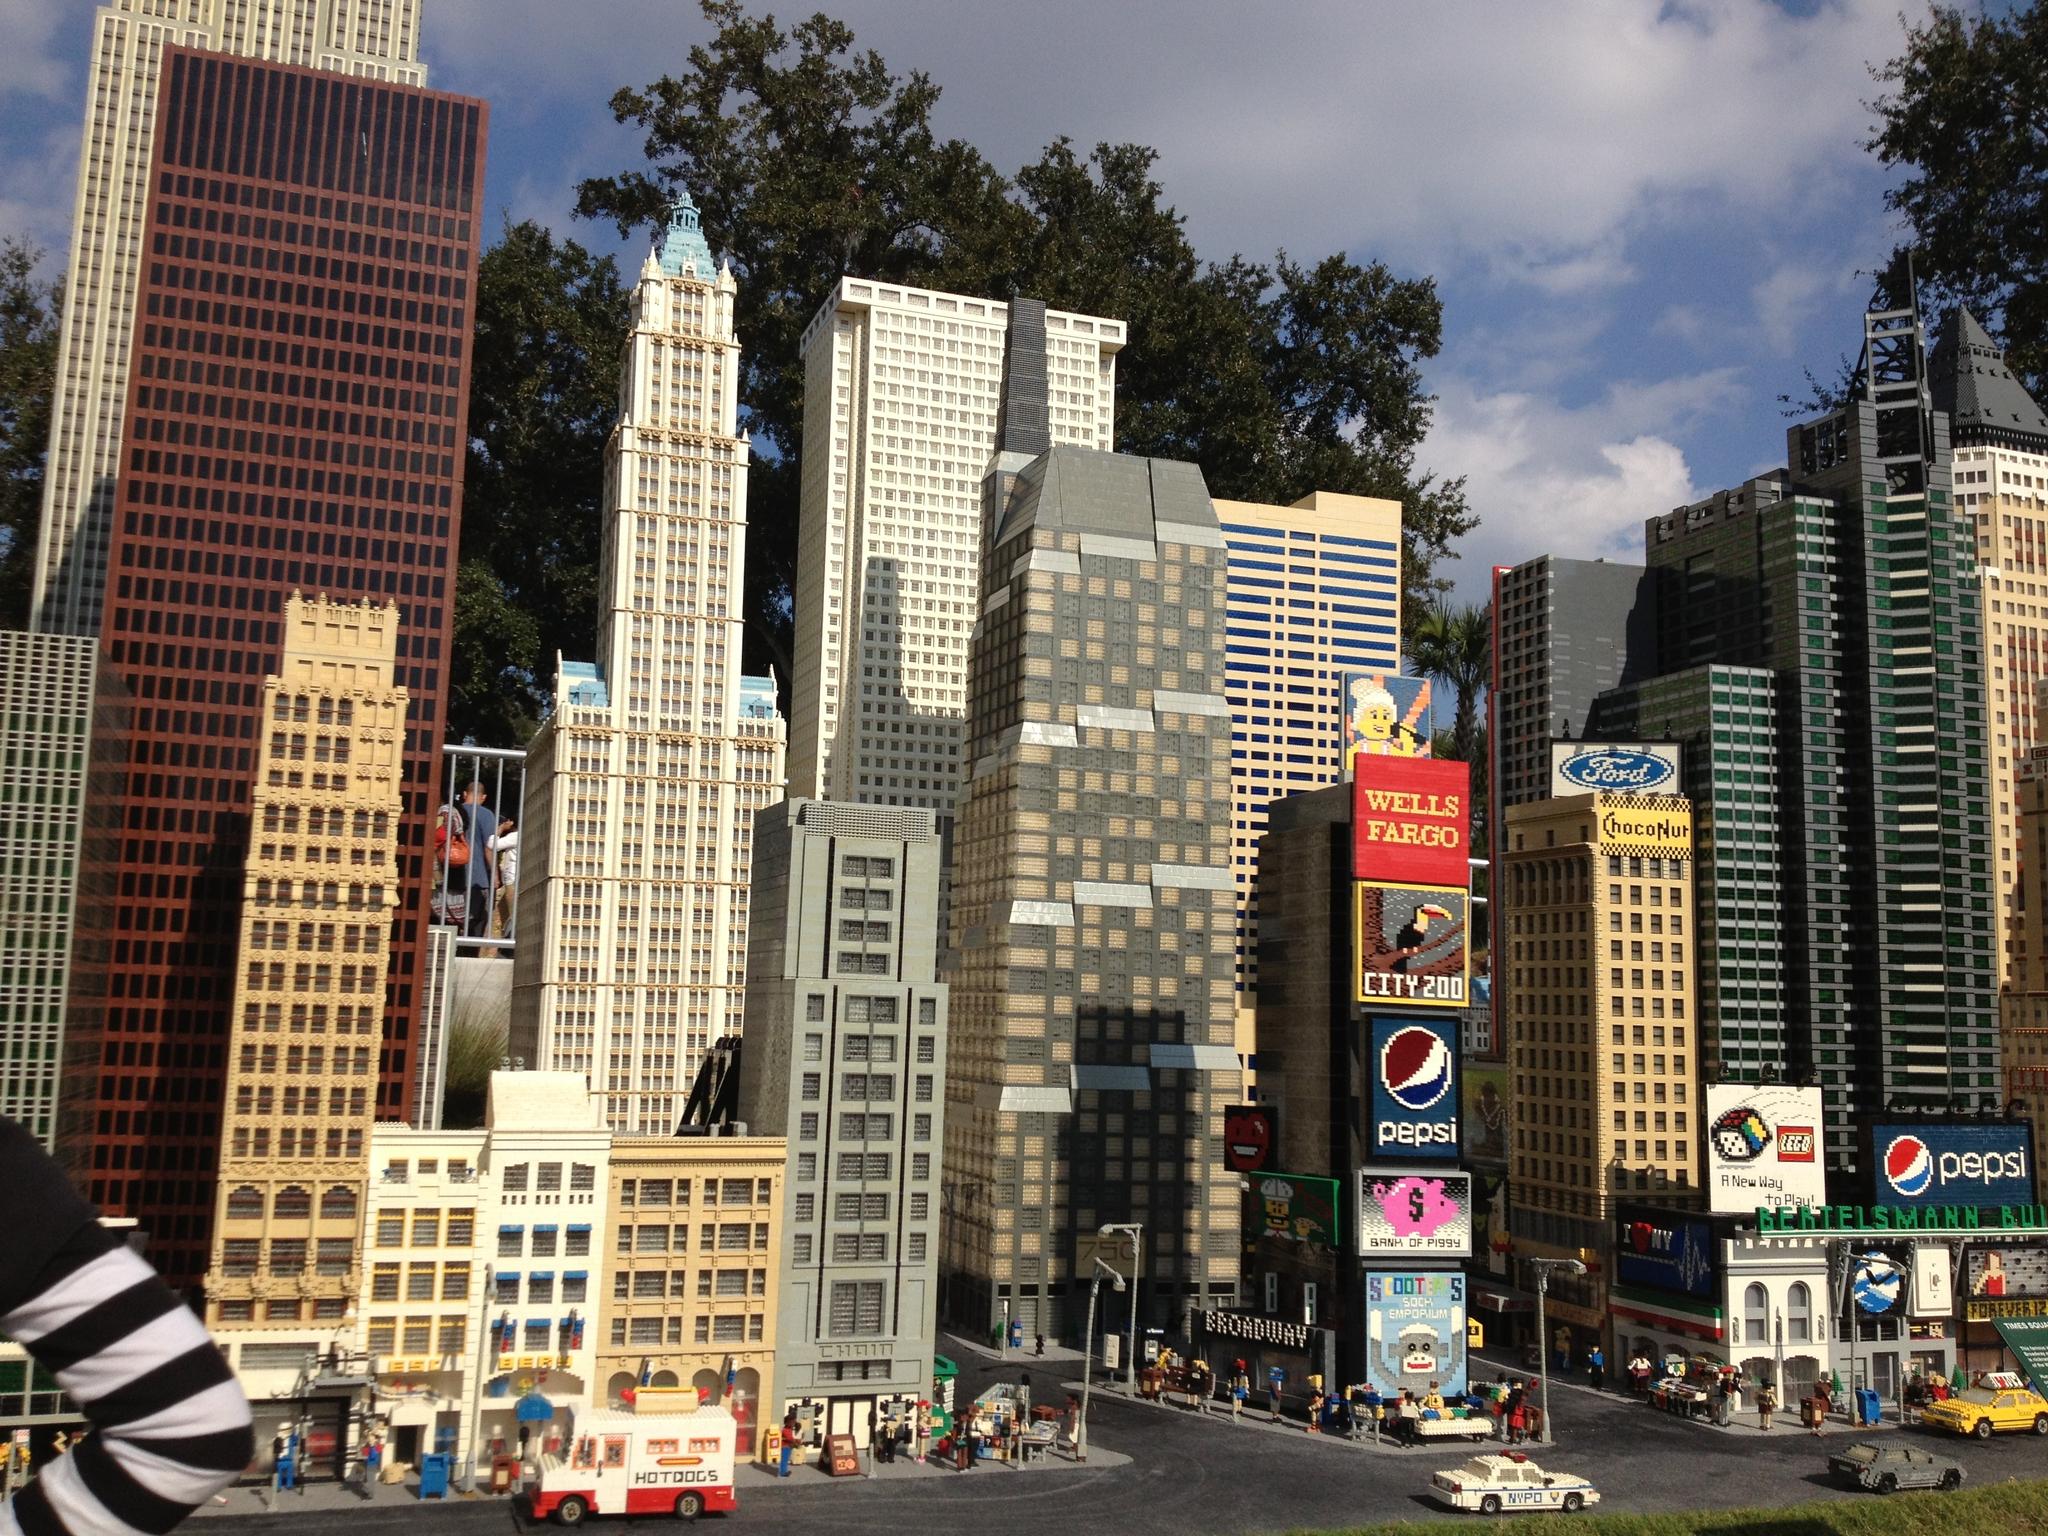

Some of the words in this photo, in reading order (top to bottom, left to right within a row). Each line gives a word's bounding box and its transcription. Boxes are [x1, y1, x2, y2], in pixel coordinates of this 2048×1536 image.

[1582, 756, 1651, 782] Ford
[1365, 789, 1459, 818] WELLS
[1367, 820, 1459, 848] FARGO
[1364, 972, 1418, 997] CITY
[1378, 1117, 1457, 1147] pepsi
[1779, 1134, 1812, 1153] LEGO
[1939, 1146, 2026, 1185] pepsi
[1721, 1174, 1730, 1187] A
[1732, 1174, 1757, 1187] New
[1759, 1175, 1783, 1191] Way
[1765, 1193, 1782, 1205] to
[1755, 1205, 1979, 1231] BERTELSMANN
[1370, 1238, 1404, 1248] BANK
[1409, 1239, 1423, 1248] OF
[1651, 1228, 1673, 1251] NY
[1402, 1297, 1434, 1308] SOCK
[1969, 1301, 2031, 1320] FOREVER
[1388, 1308, 1448, 1320] EMPORIUM
[1205, 1310, 1308, 1348] BROADWAY
[2003, 1322, 2028, 1330] TIMES
[1508, 1492, 1542, 1504] NYPD
